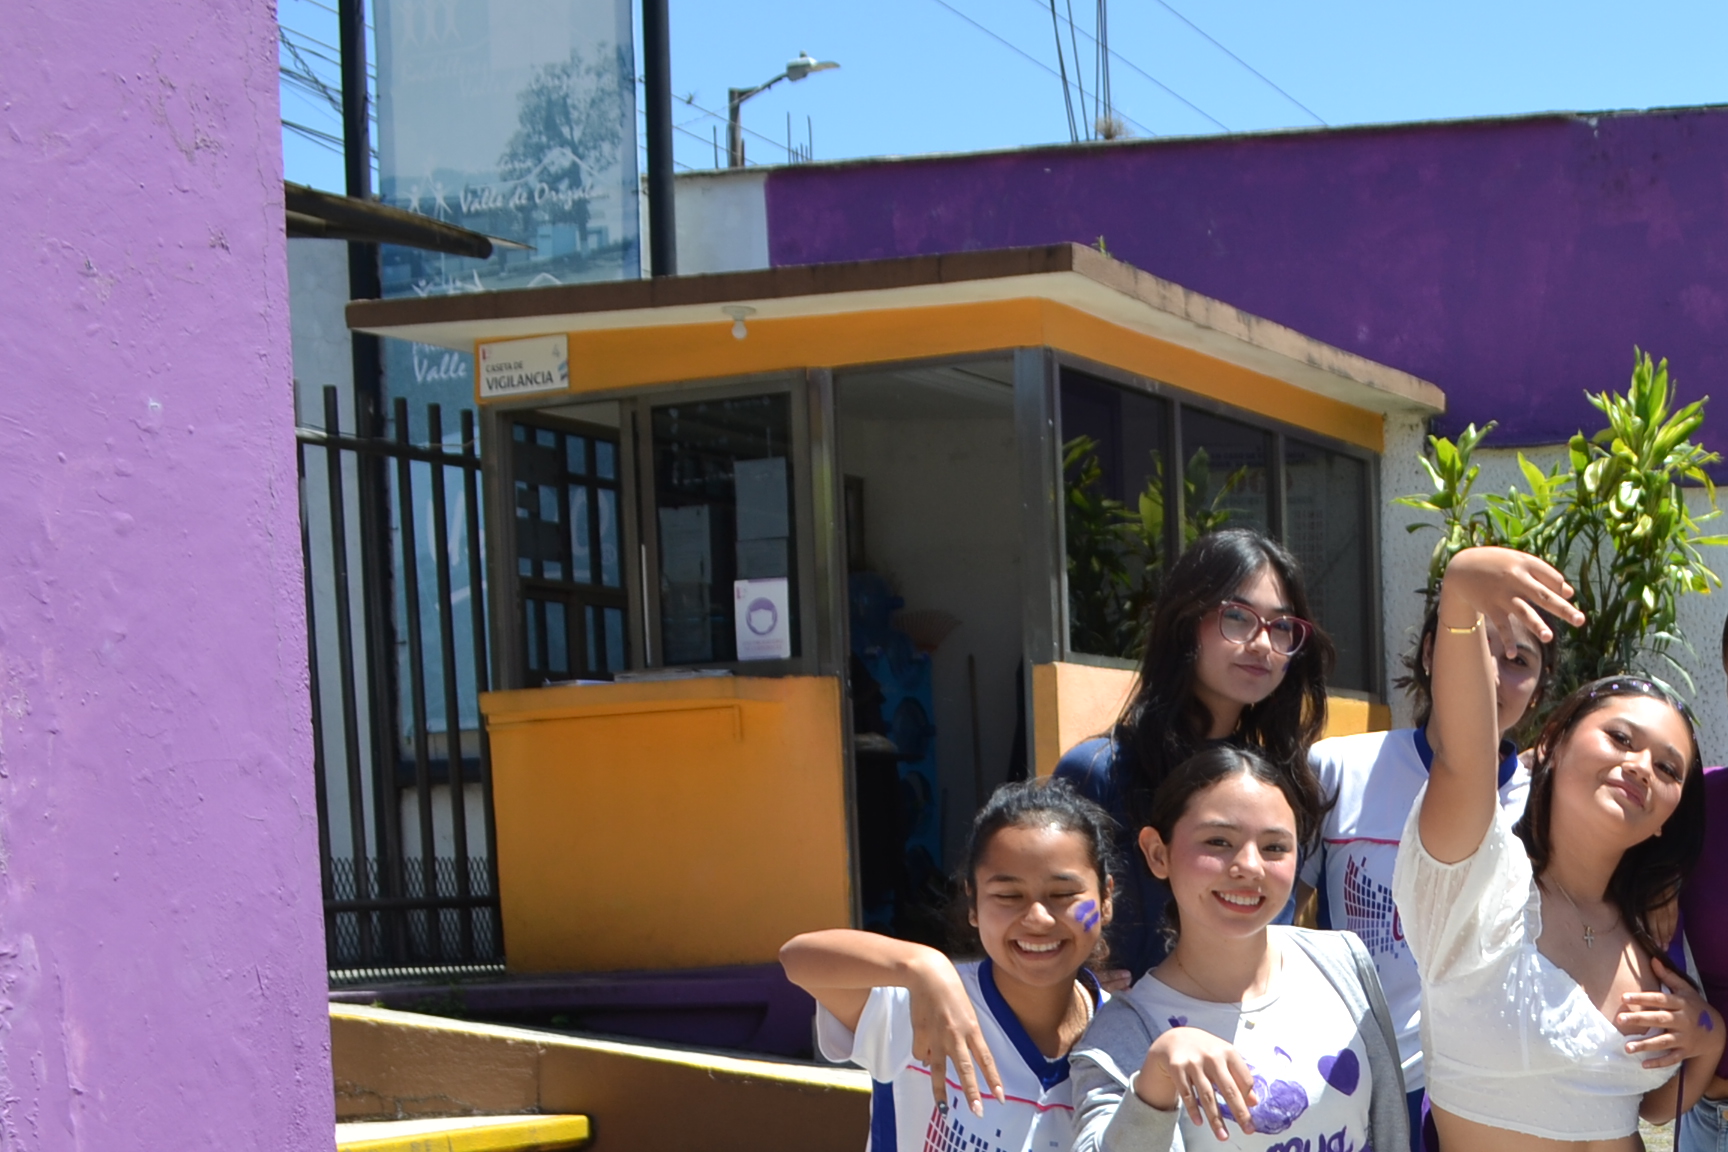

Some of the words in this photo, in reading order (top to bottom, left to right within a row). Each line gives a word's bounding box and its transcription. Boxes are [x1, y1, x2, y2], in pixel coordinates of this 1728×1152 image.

[412, 351, 467, 384] Valle
[485, 361, 513, 373] CASETA
[513, 360, 523, 370] DE
[485, 370, 554, 391] VIGILANCIA
